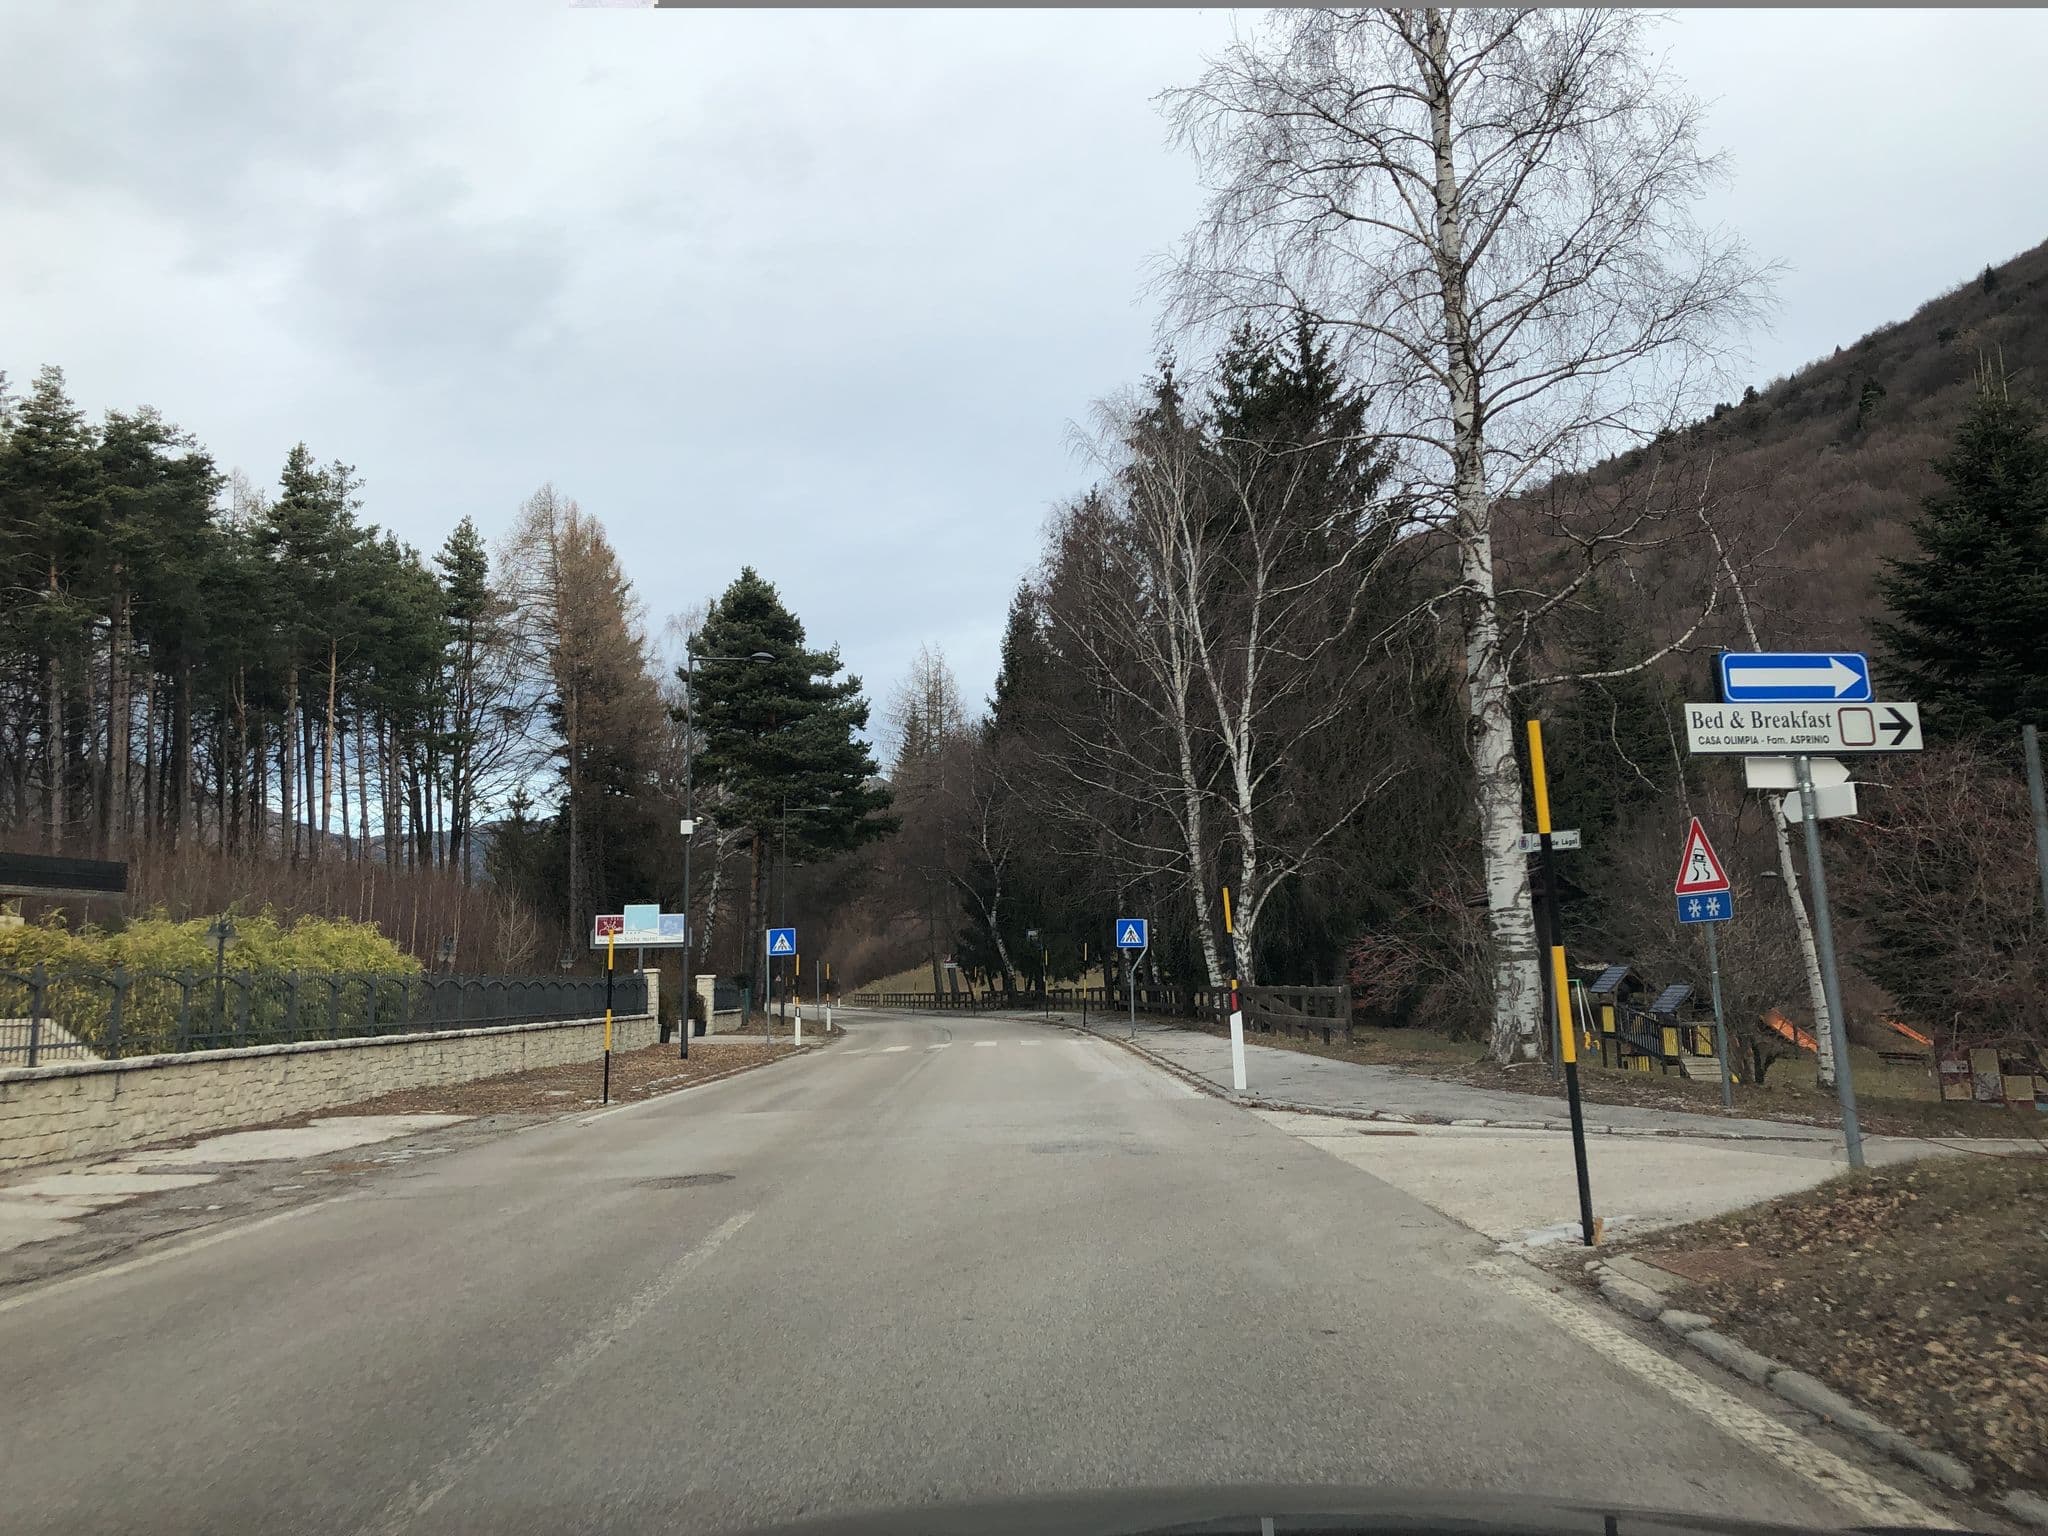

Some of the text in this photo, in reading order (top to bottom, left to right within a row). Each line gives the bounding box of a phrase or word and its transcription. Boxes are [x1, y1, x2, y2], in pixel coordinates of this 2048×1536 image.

[1692, 710, 1832, 729] Bed & Breakfast
[1698, 735, 1721, 745] CASA
[1724, 735, 1759, 745] OLIMPIA
[1766, 735, 1788, 745] Fam.
[1790, 735, 1830, 744] ASPRINIO
